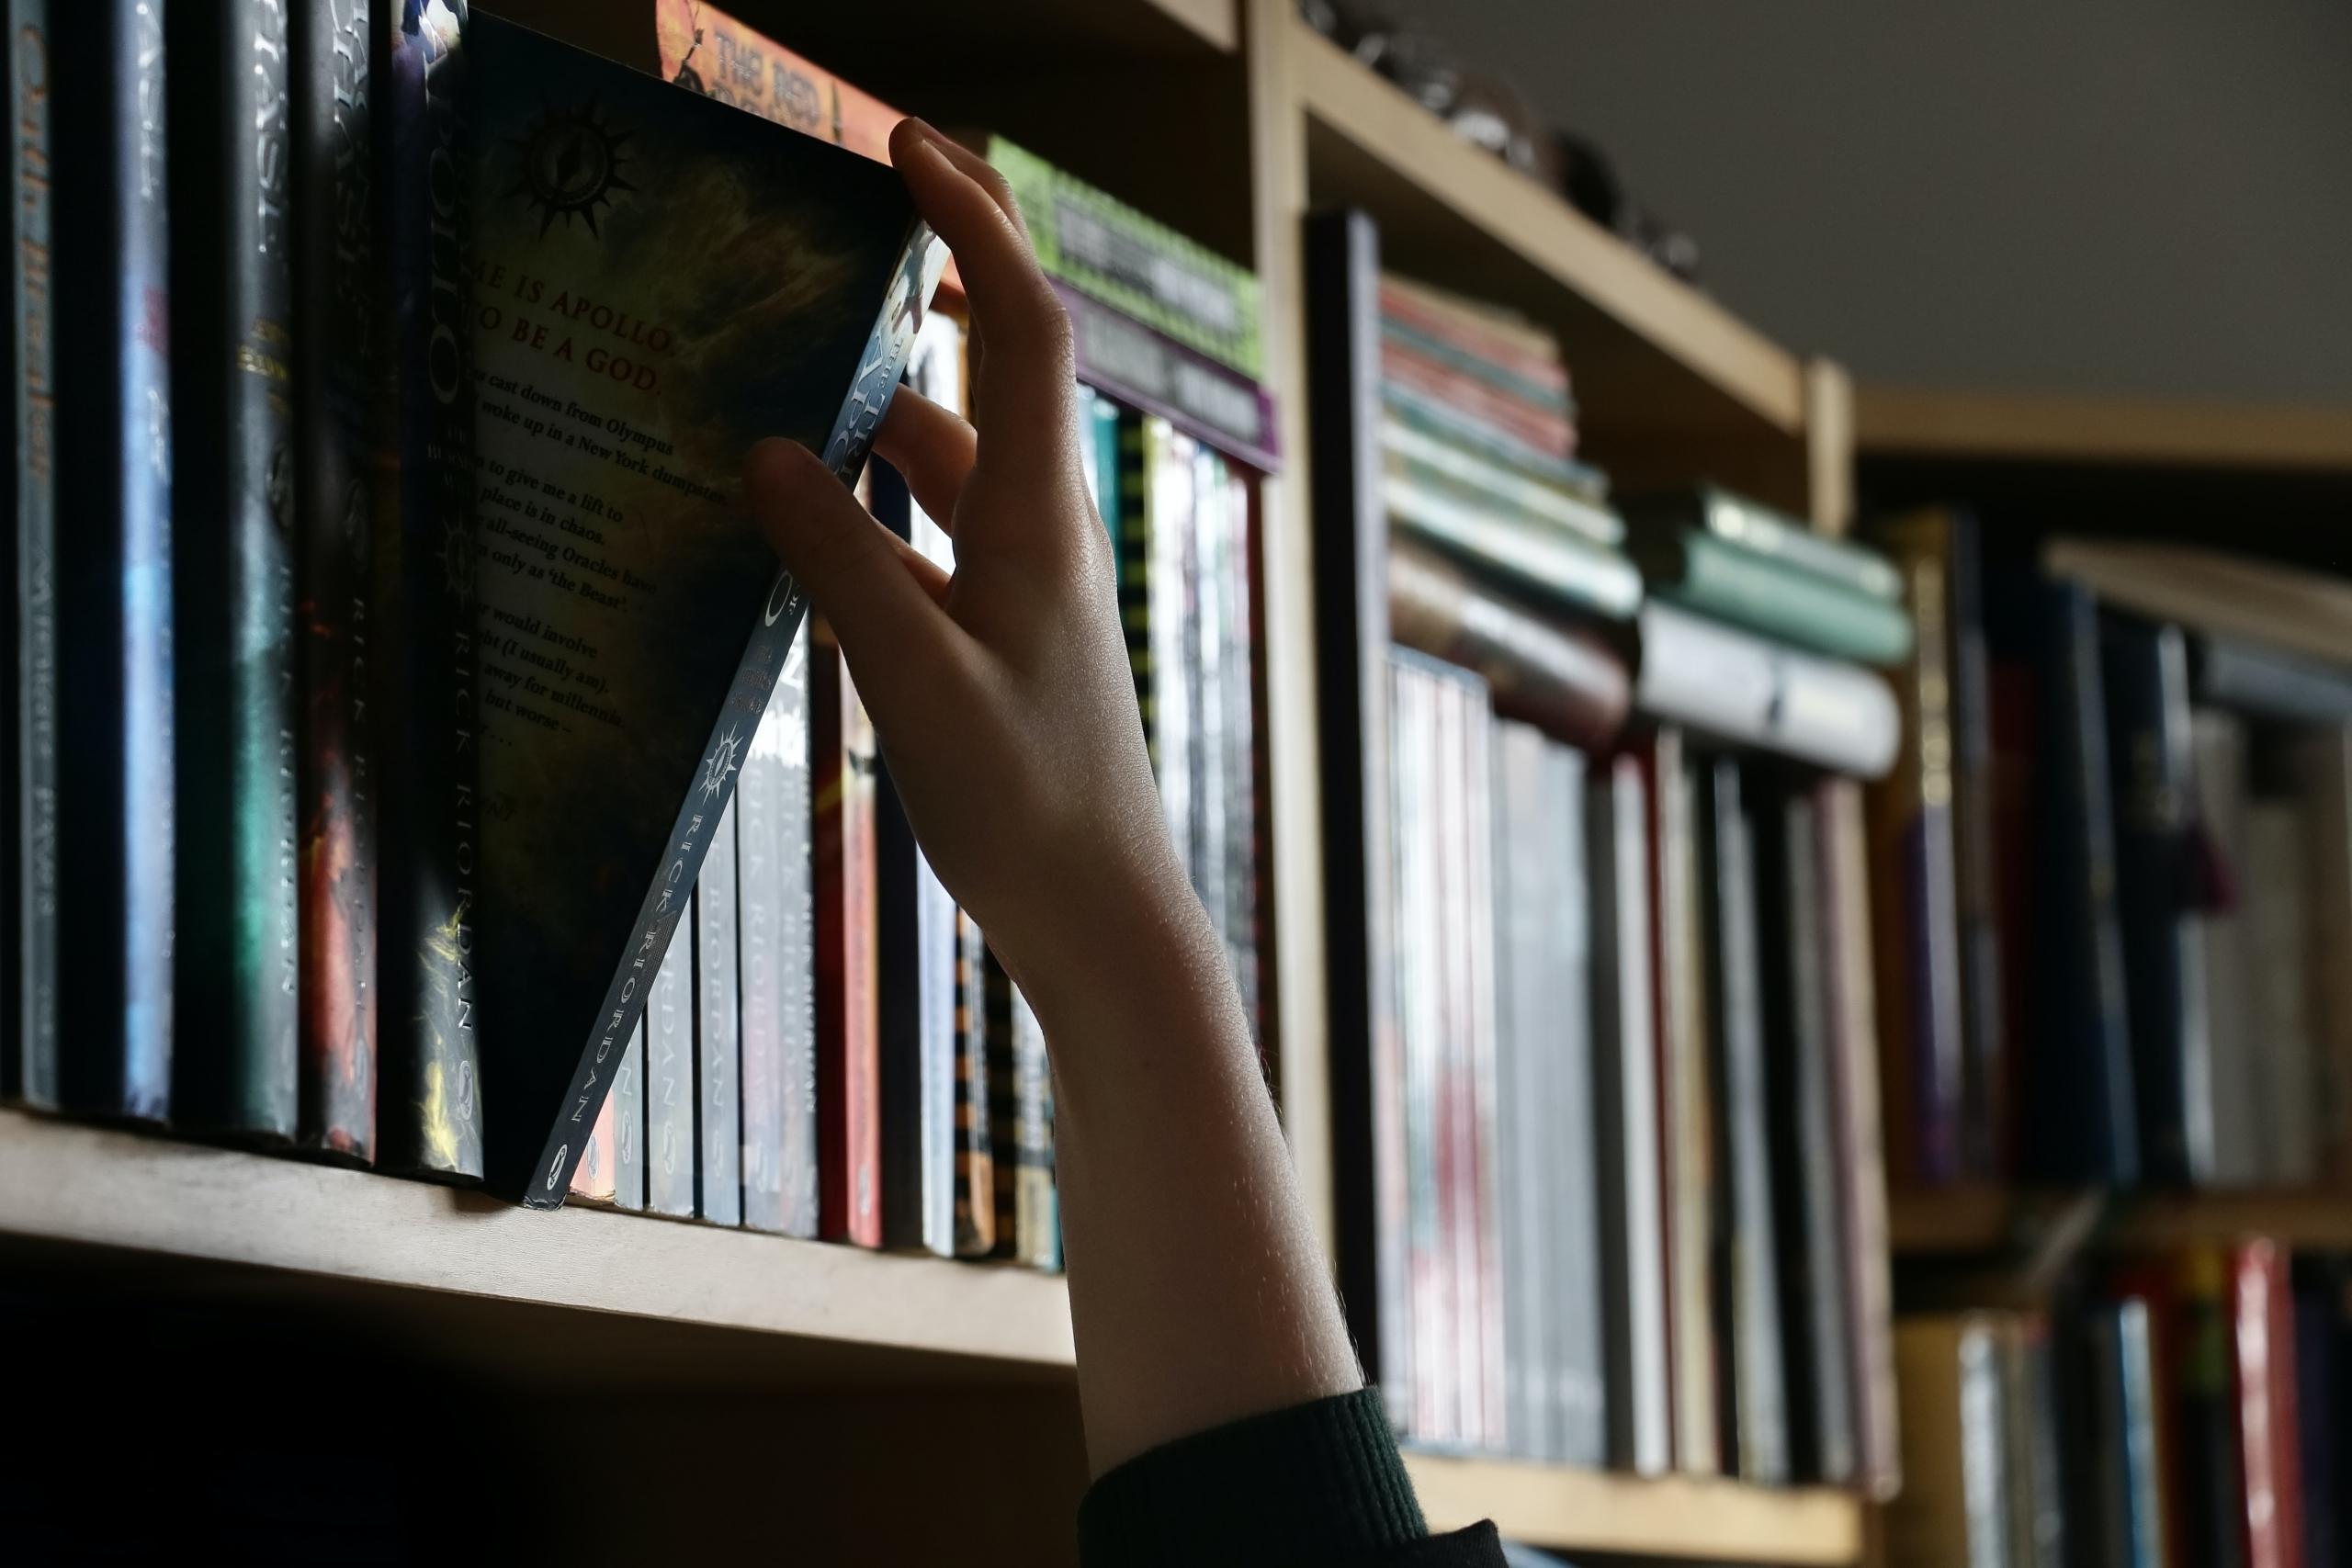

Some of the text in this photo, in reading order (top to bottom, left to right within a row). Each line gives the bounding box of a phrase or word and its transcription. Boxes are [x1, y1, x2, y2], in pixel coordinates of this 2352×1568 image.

[514, 275, 546, 303] IS
[510, 316, 550, 351] BE
[552, 336, 574, 363] A
[585, 346, 662, 398] GOD.
[482, 400, 522, 425] woke
[523, 416, 545, 437] up
[546, 422, 563, 442] in
[565, 434, 576, 447] a
[577, 434, 614, 461] New
[616, 449, 650, 476] York
[489, 374, 519, 396] cast
[520, 383, 563, 412] down
[565, 400, 604, 429] from
[606, 418, 675, 457] Olympus
[480, 486, 606, 547] place is in chaos.
[489, 459, 505, 477] to
[505, 467, 540, 491] give
[542, 480, 567, 501] me
[567, 491, 578, 505] a
[580, 492, 605, 515] lift
[606, 506, 625, 523] to
[486, 517, 658, 595] all-seeing Oracles have
[492, 551, 527, 576] only
[527, 564, 546, 580] as
[492, 606, 599, 660] would involve
[519, 648, 574, 682] usually
[483, 662, 523, 690] away
[523, 675, 550, 697] for
[484, 688, 514, 713] but
[515, 705, 560, 731] worse
[455, 629, 474, 1032] RICK RIORDAN
[571, 813, 705, 1124] RICK RIORDAN
[707, 887, 725, 1108] RIORDAN
[660, 953, 677, 1108] RDAN
